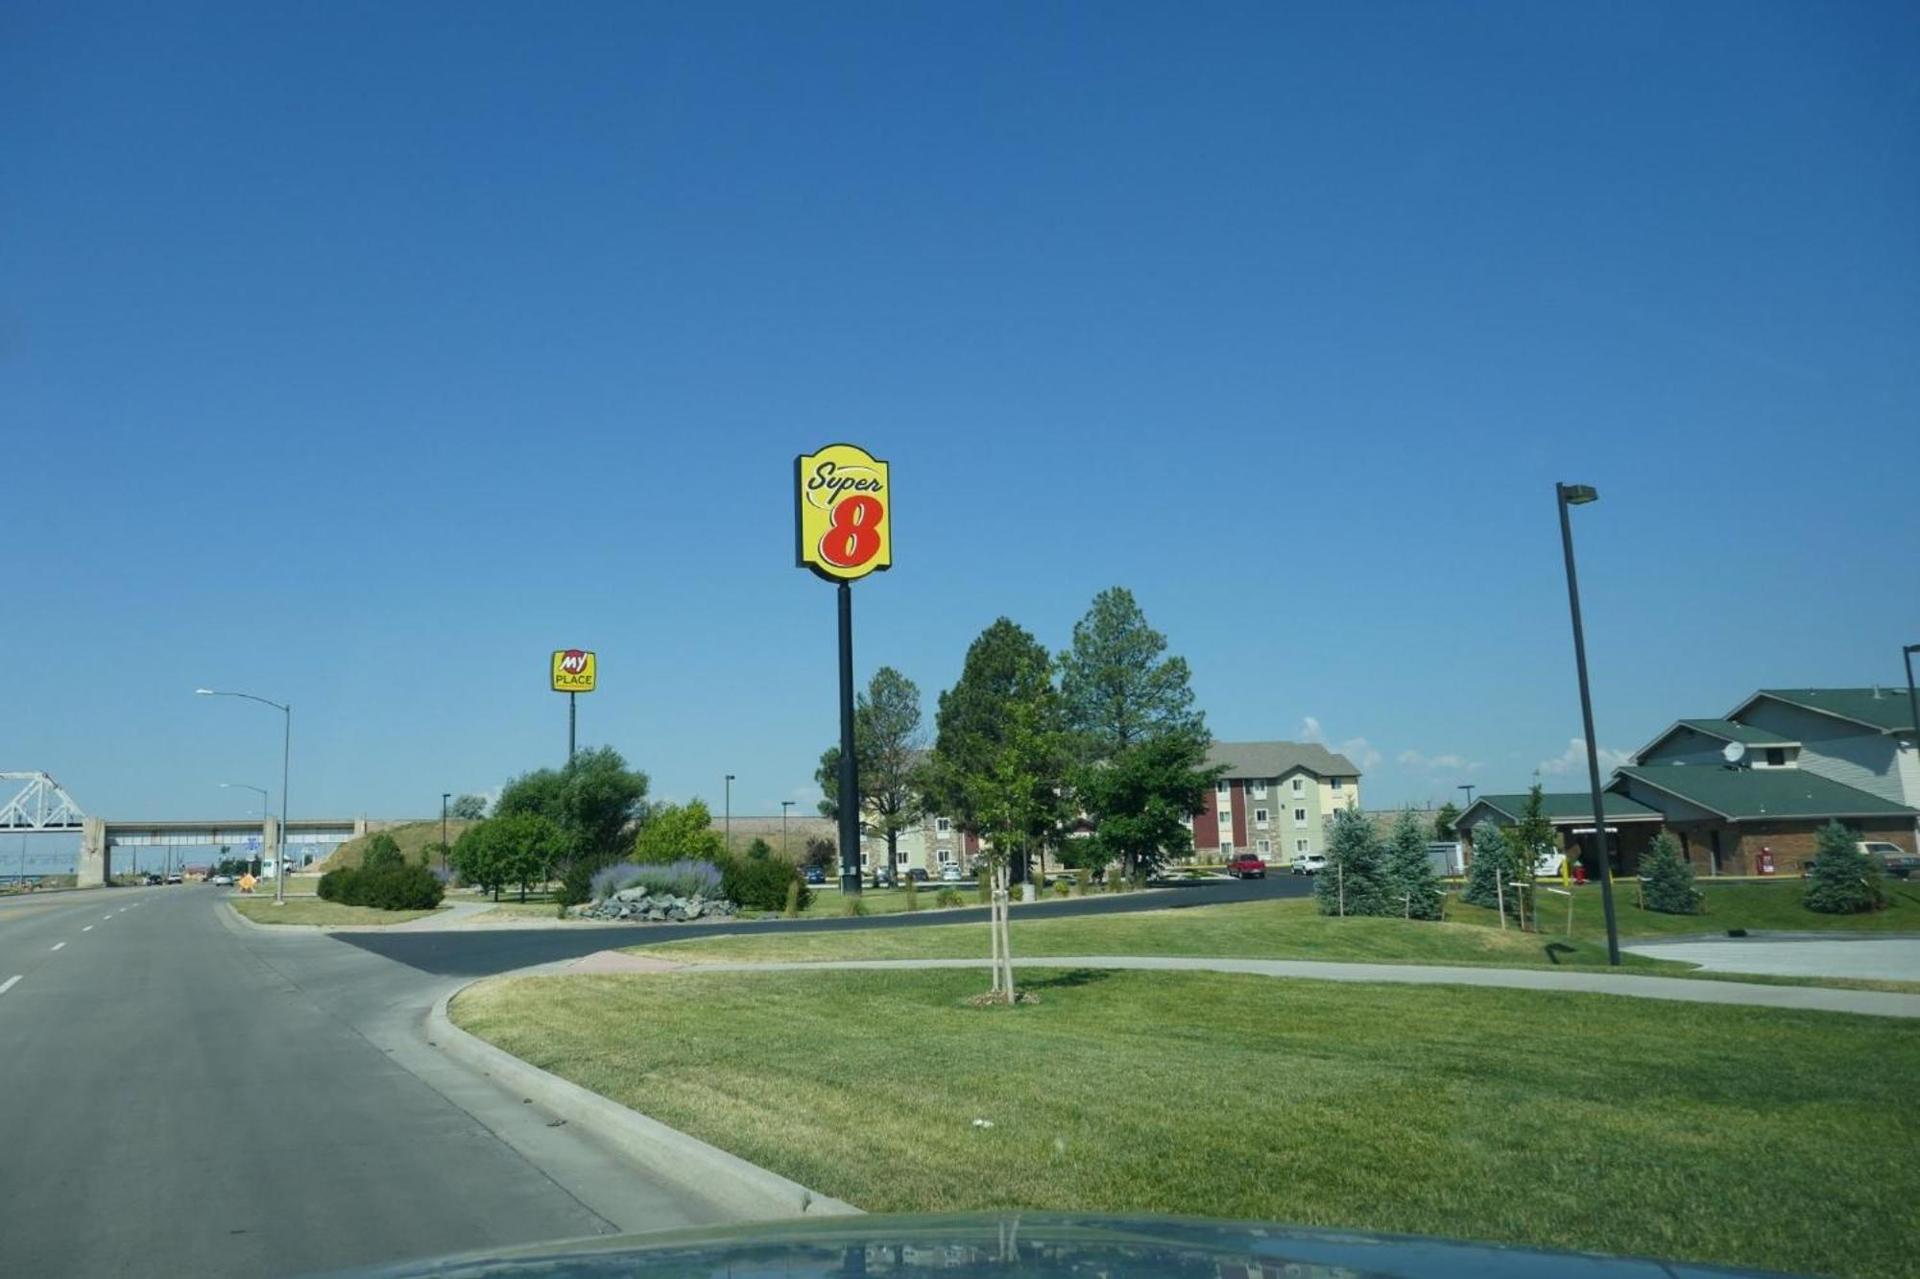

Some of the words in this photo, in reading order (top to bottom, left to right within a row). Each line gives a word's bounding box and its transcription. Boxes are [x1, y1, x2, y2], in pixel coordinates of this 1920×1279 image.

[808, 461, 883, 505] Super
[818, 495, 884, 568] 8
[556, 674, 593, 685] PLACE
